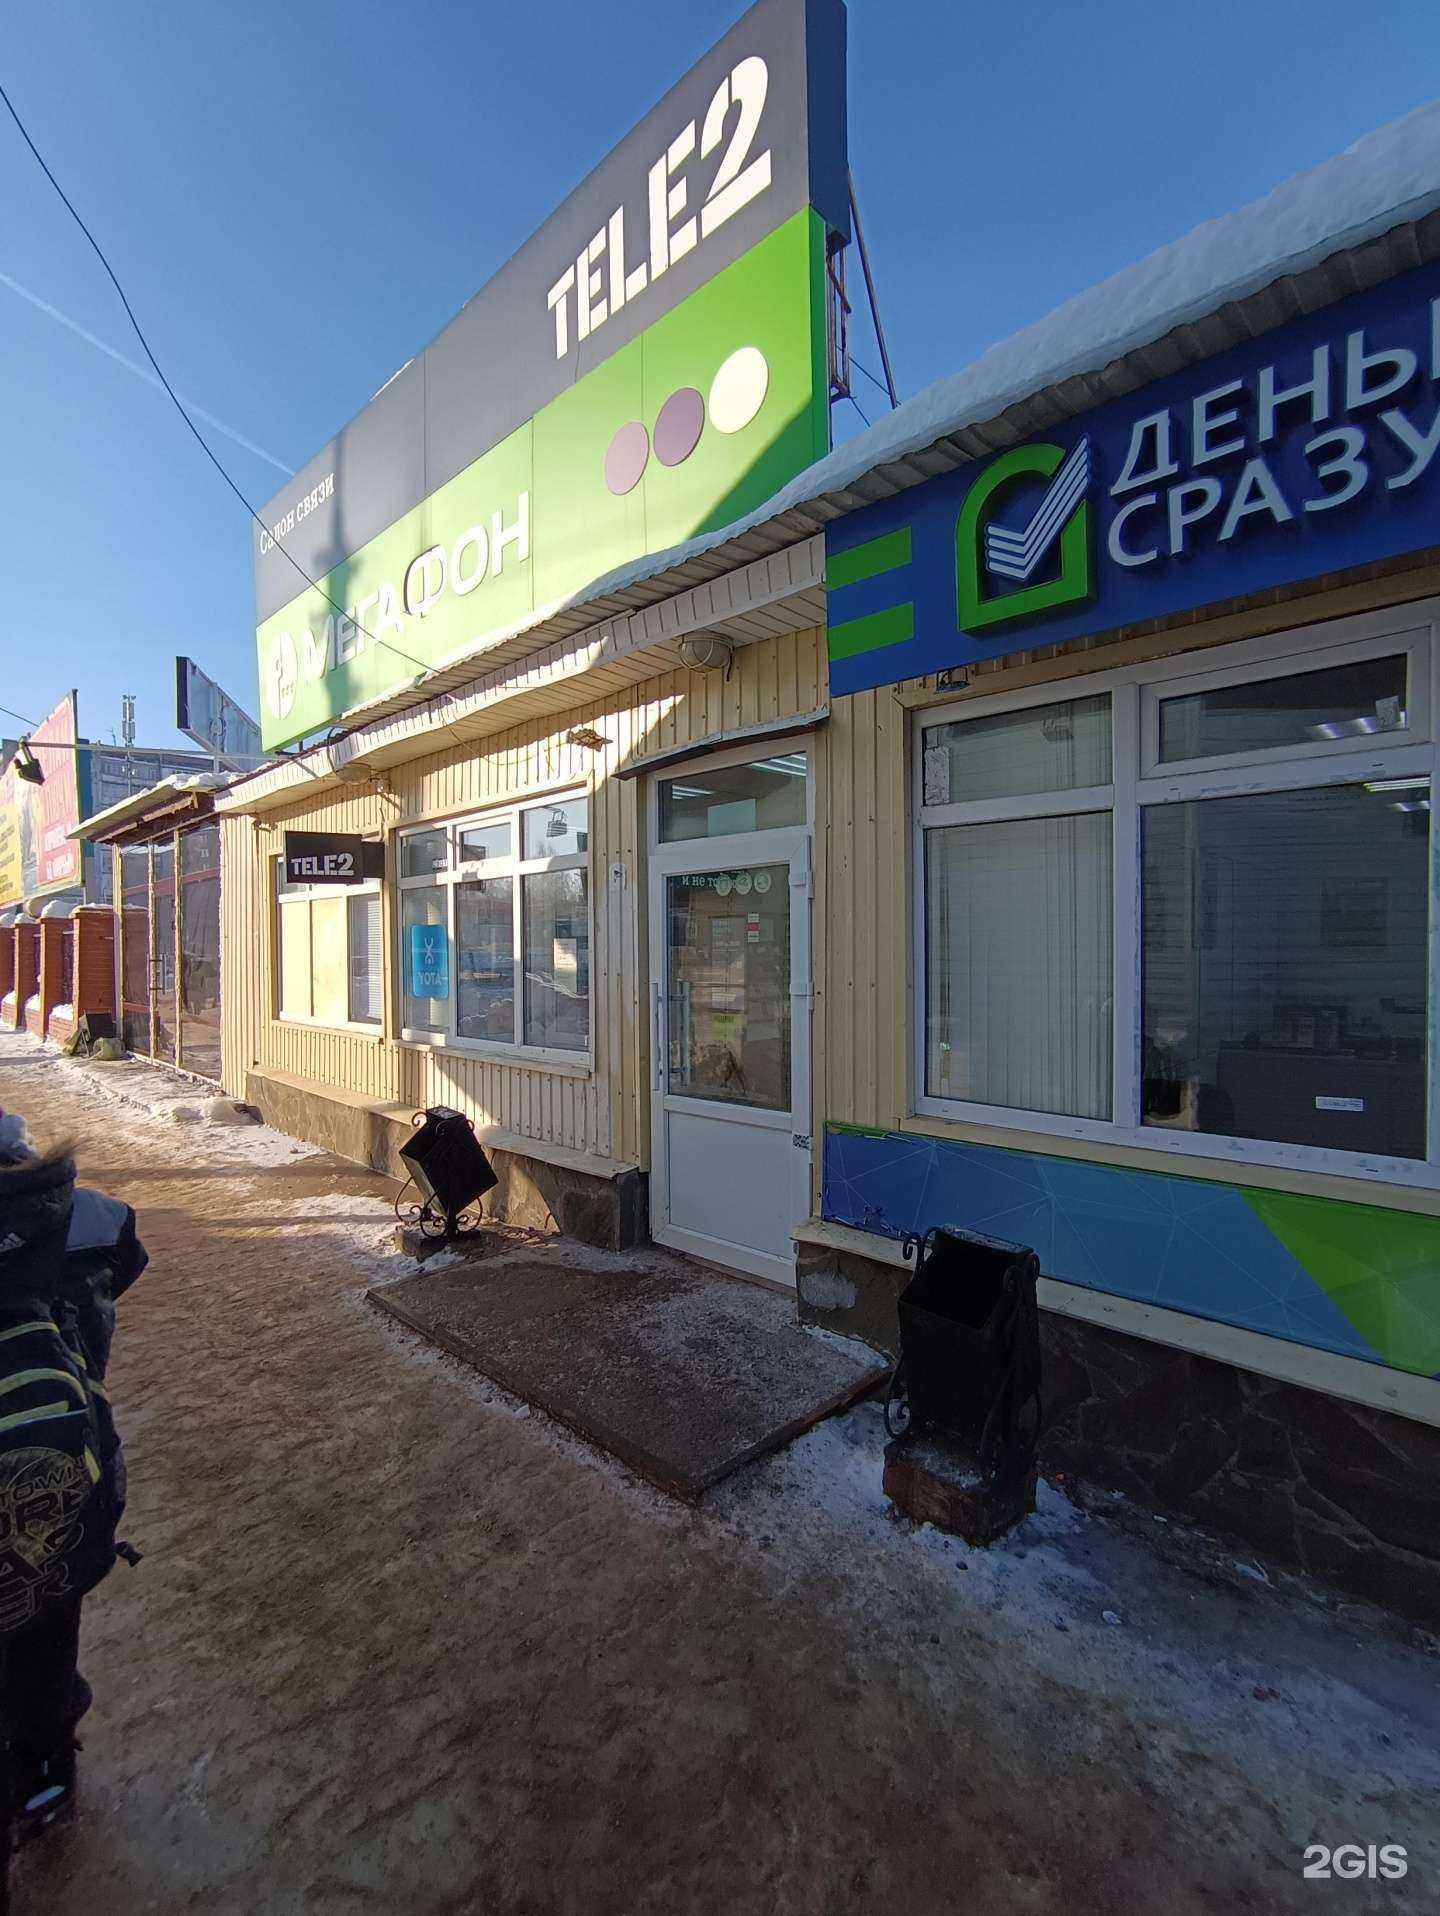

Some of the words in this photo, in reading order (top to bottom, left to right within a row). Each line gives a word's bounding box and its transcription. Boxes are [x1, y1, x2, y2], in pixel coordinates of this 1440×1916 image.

[547, 56, 771, 360] TELE2
[1108, 406, 1440, 567] СРАЗУ
[301, 490, 530, 684] МЕГАФОН
[290, 853, 354, 876] TELE2
